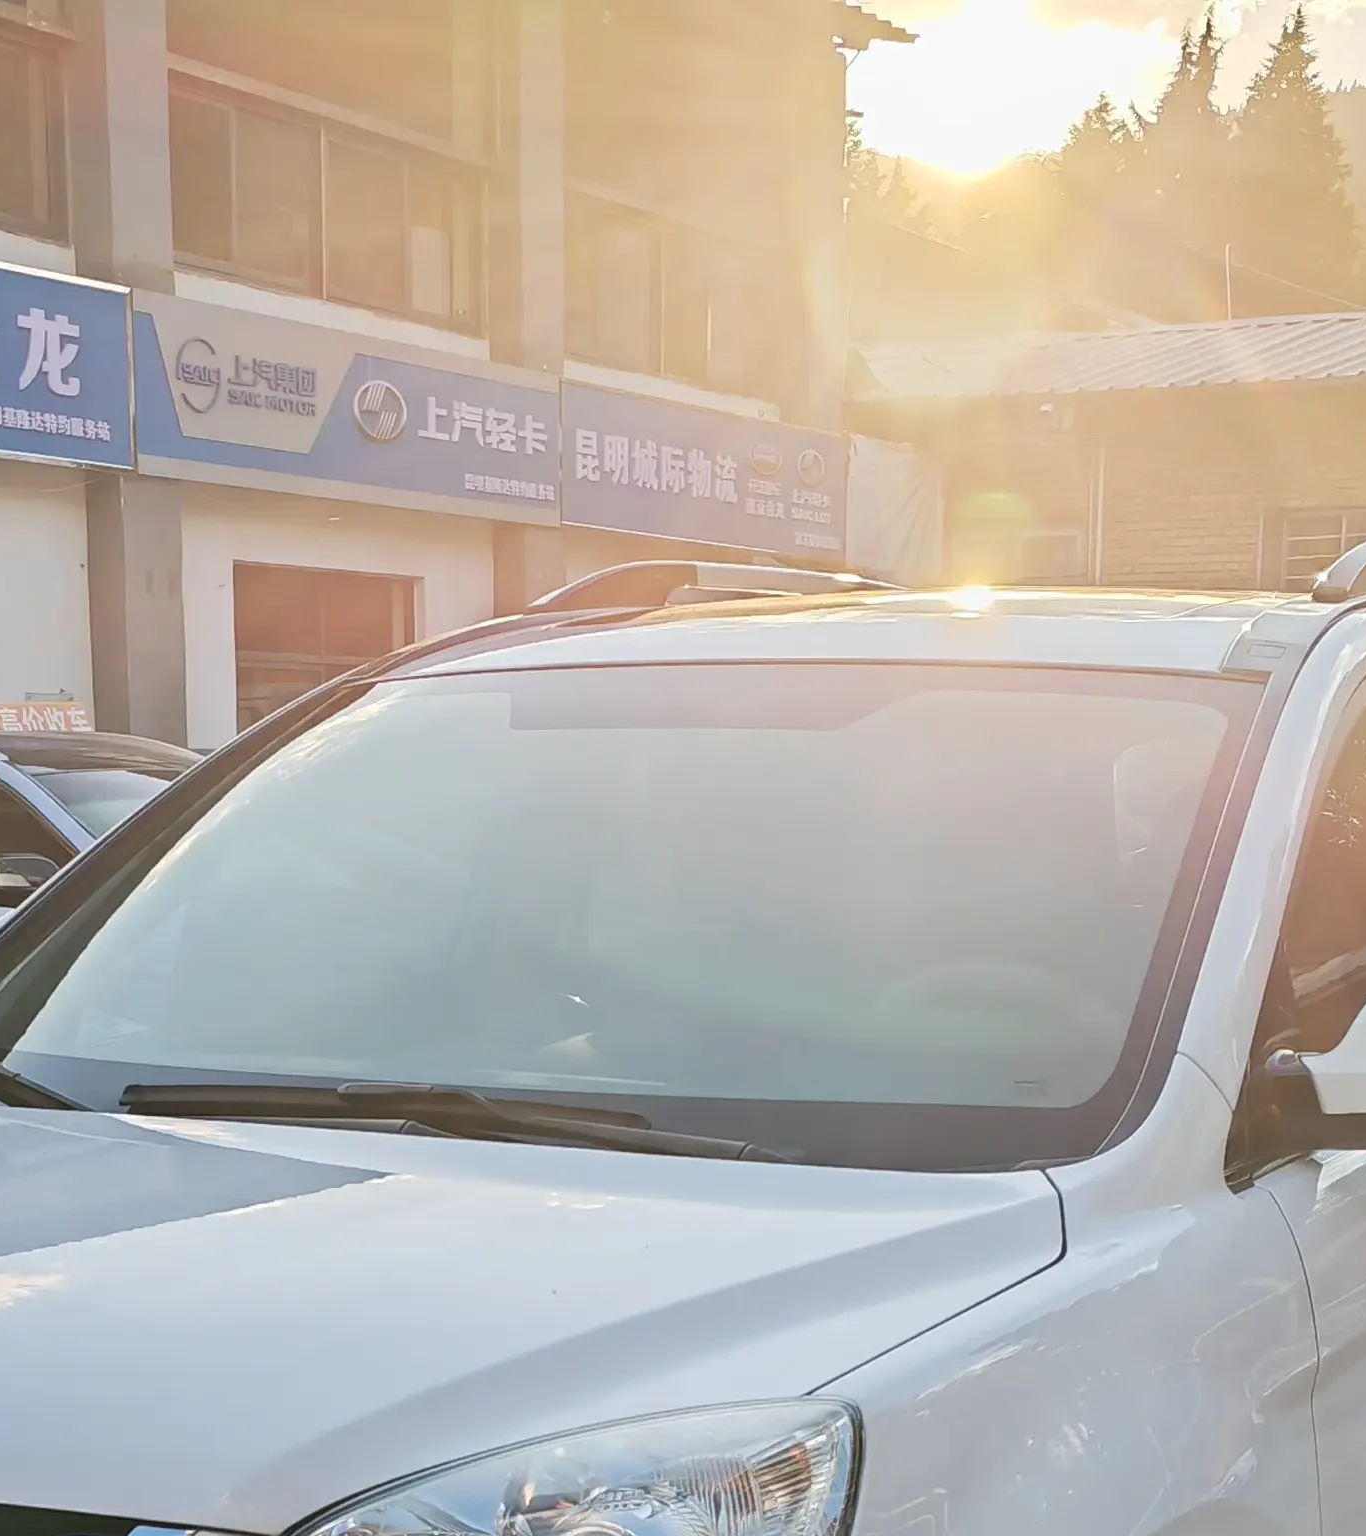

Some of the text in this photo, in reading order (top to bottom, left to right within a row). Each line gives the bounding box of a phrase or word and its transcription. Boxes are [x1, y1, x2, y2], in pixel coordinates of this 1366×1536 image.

[227, 354, 317, 398] 上汽集团
[417, 396, 548, 455] 上汽轻卡
[576, 428, 738, 504] 昆明城际物流
